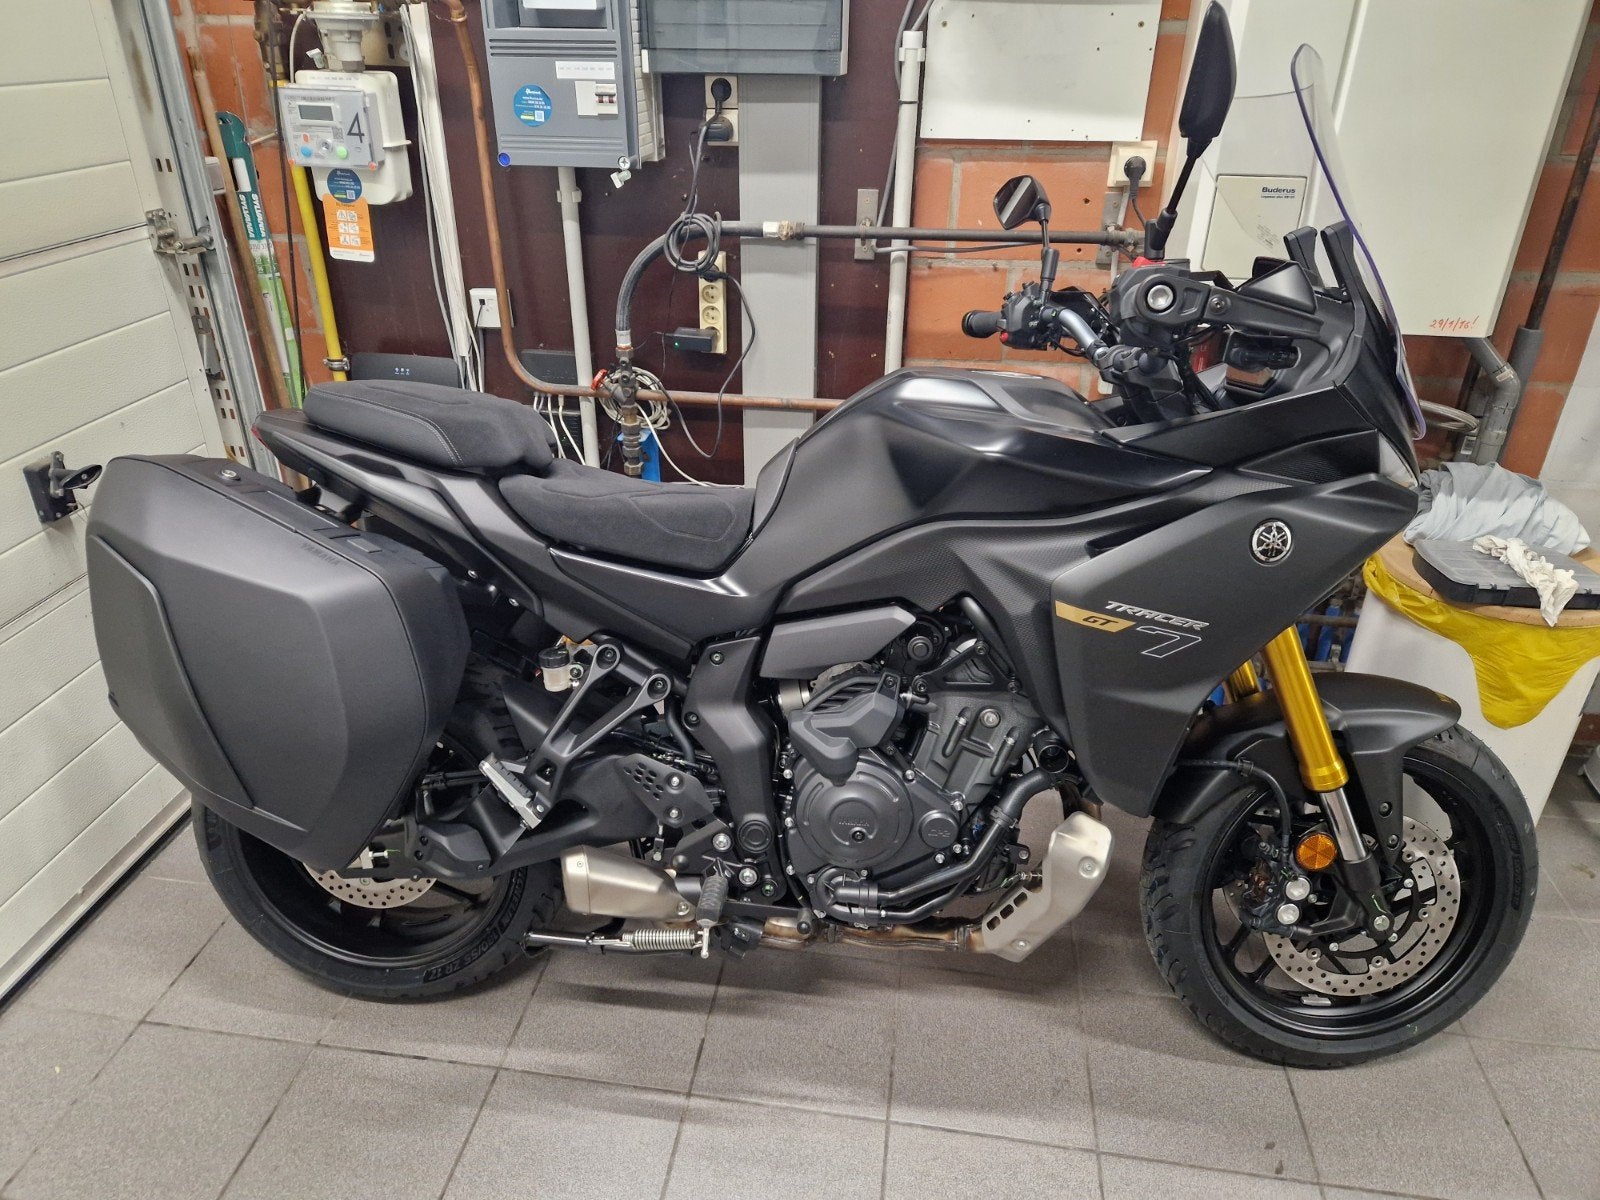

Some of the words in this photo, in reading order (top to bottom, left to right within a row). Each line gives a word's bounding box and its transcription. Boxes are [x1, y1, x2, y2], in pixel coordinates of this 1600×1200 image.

[347, 112, 365, 144] 4
[1261, 186, 1296, 194] Buderus
[239, 193, 255, 238] SYLVANIA
[251, 193, 266, 238] SYLVANIA
[1083, 615, 1119, 627] GT
[1105, 601, 1209, 630] TRACER
[1136, 625, 1203, 659] 7
